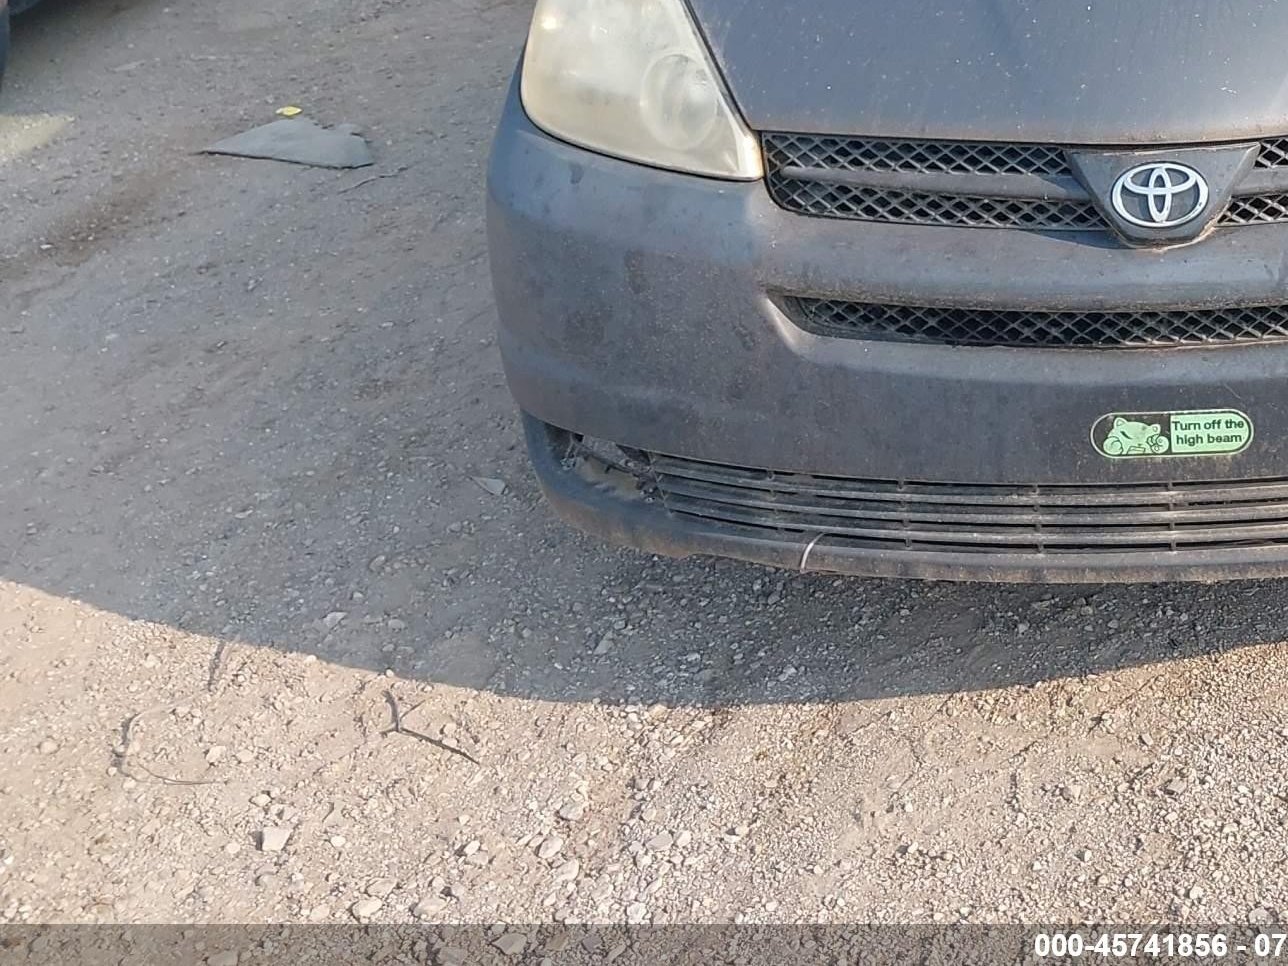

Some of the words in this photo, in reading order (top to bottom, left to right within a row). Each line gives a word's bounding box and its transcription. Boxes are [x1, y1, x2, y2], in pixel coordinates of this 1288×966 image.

[1171, 420, 1201, 431] Turn
[1203, 419, 1221, 430] off
[1225, 418, 1244, 429] the
[1176, 434, 1204, 447] high
[1207, 433, 1242, 444] beam
